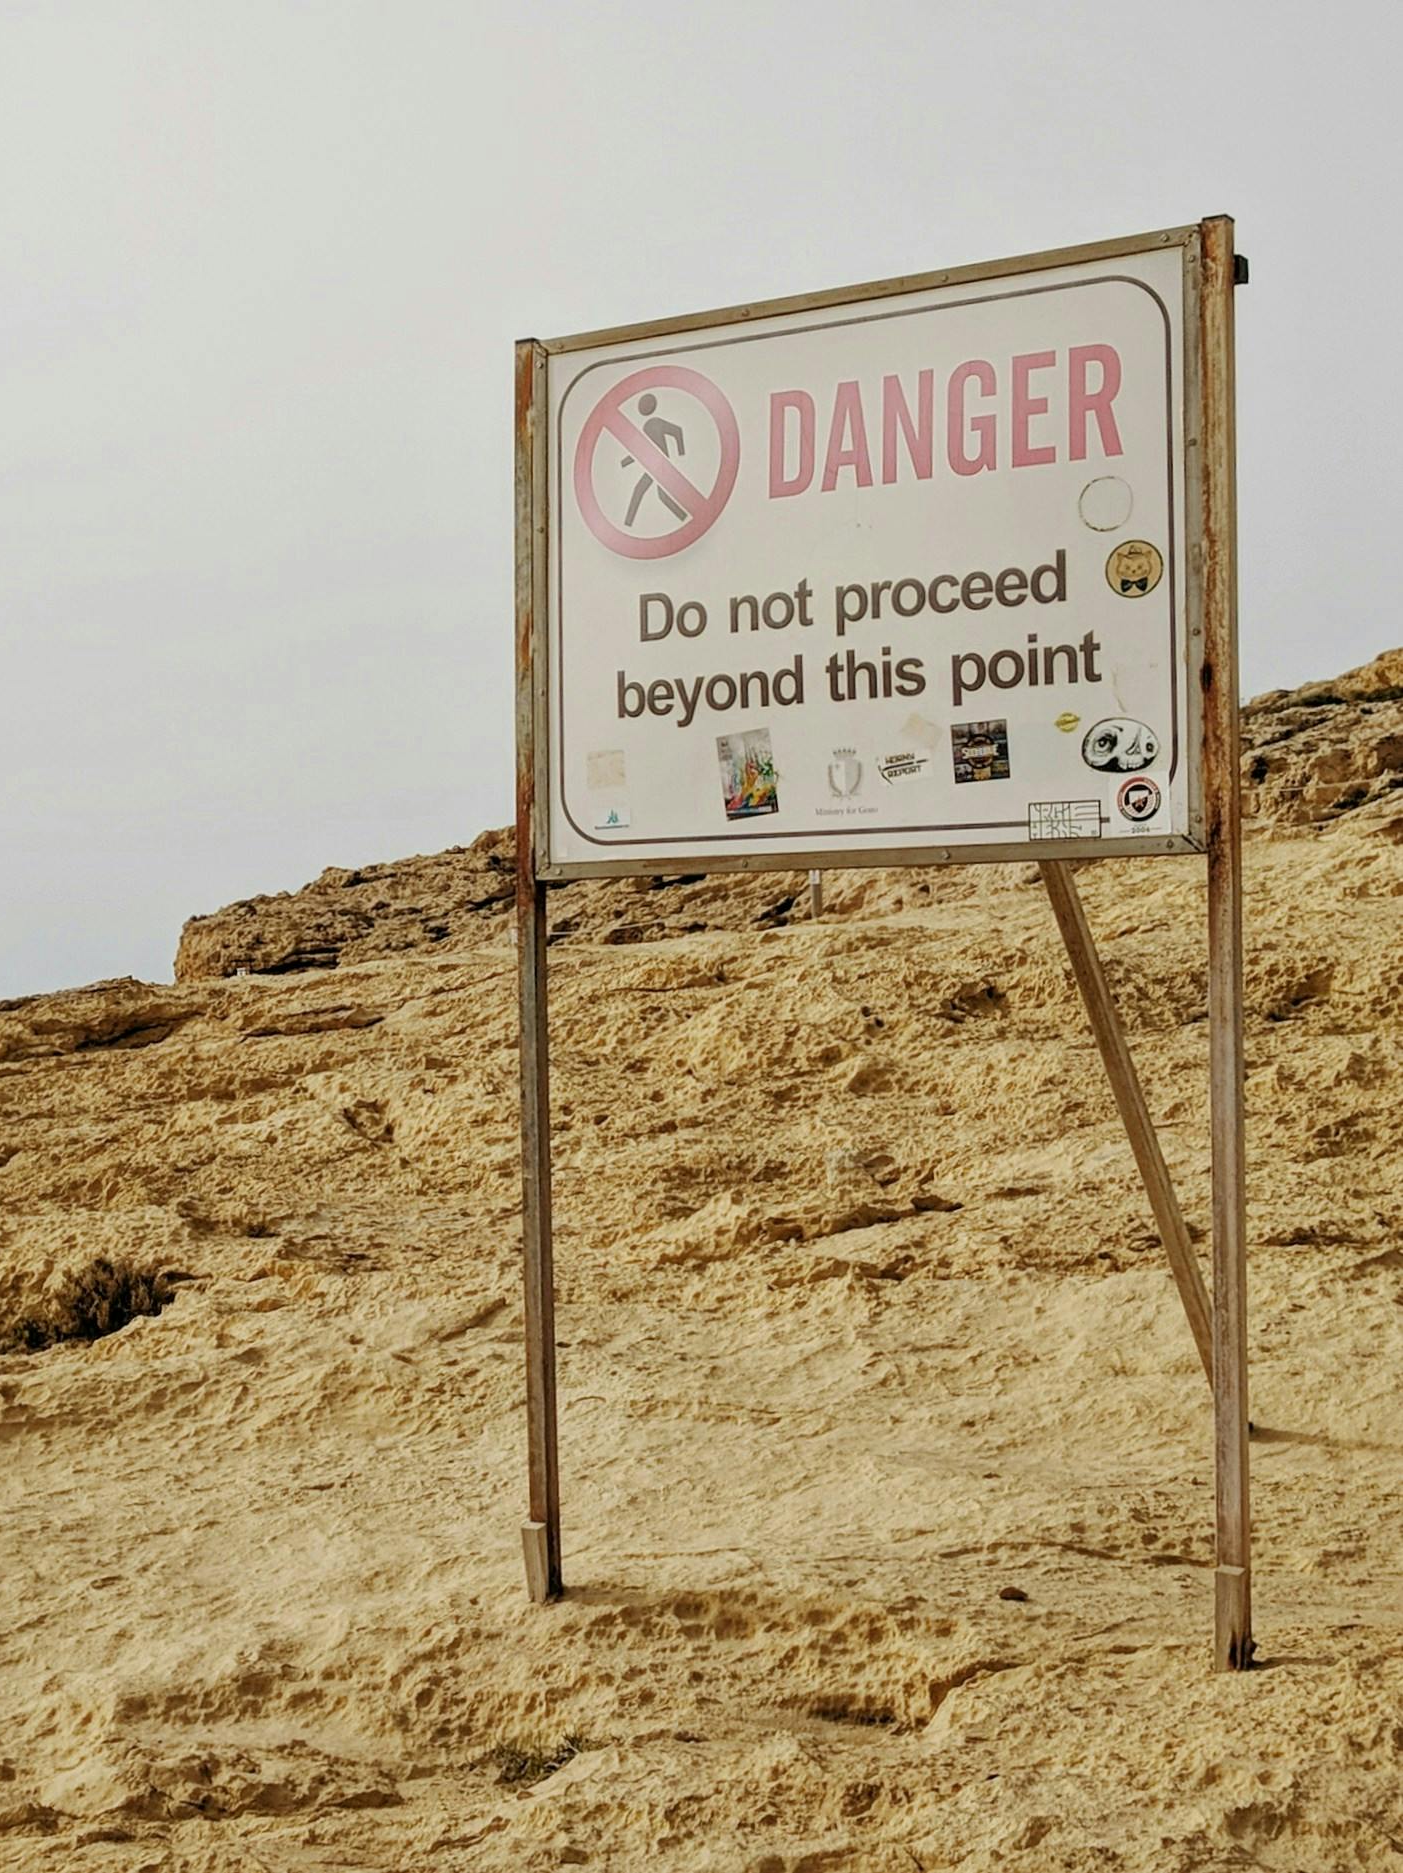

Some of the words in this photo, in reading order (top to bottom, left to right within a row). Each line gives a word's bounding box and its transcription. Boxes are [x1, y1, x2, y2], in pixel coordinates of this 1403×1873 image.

[768, 343, 1124, 499] DANGER
[639, 592, 708, 643] Do
[729, 577, 814, 634] not
[835, 548, 1068, 637] proceed
[617, 653, 805, 729] beyond
[824, 645, 927, 703] this
[951, 629, 1103, 708] point
[887, 765, 922, 778] REPORT
